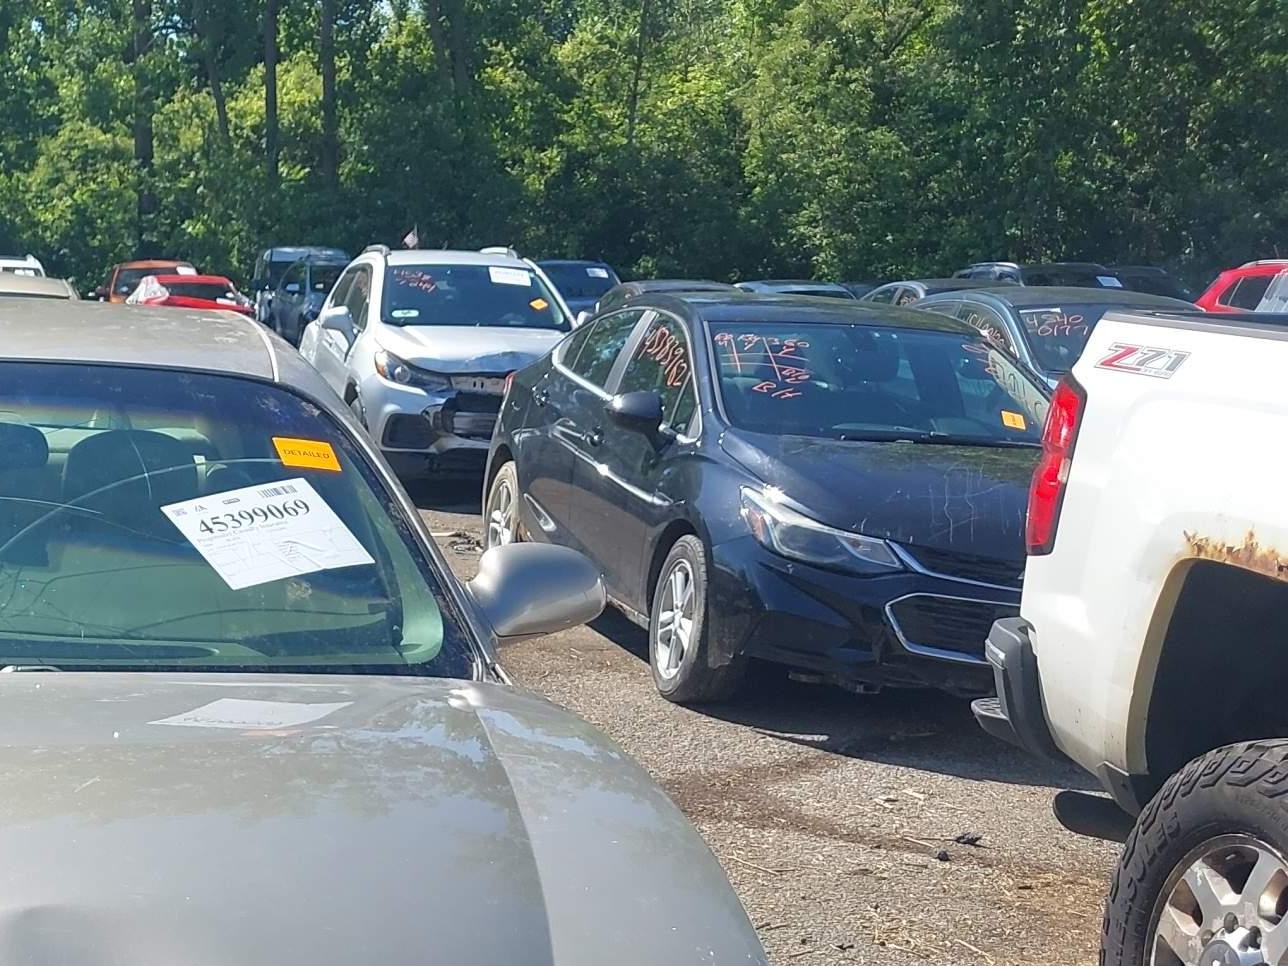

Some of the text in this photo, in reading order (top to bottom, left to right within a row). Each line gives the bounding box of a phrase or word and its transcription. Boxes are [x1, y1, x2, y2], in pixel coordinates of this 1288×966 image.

[1096, 343, 1191, 378] Z71
[283, 448, 330, 459] DETAILED
[199, 499, 311, 534] 45399069
